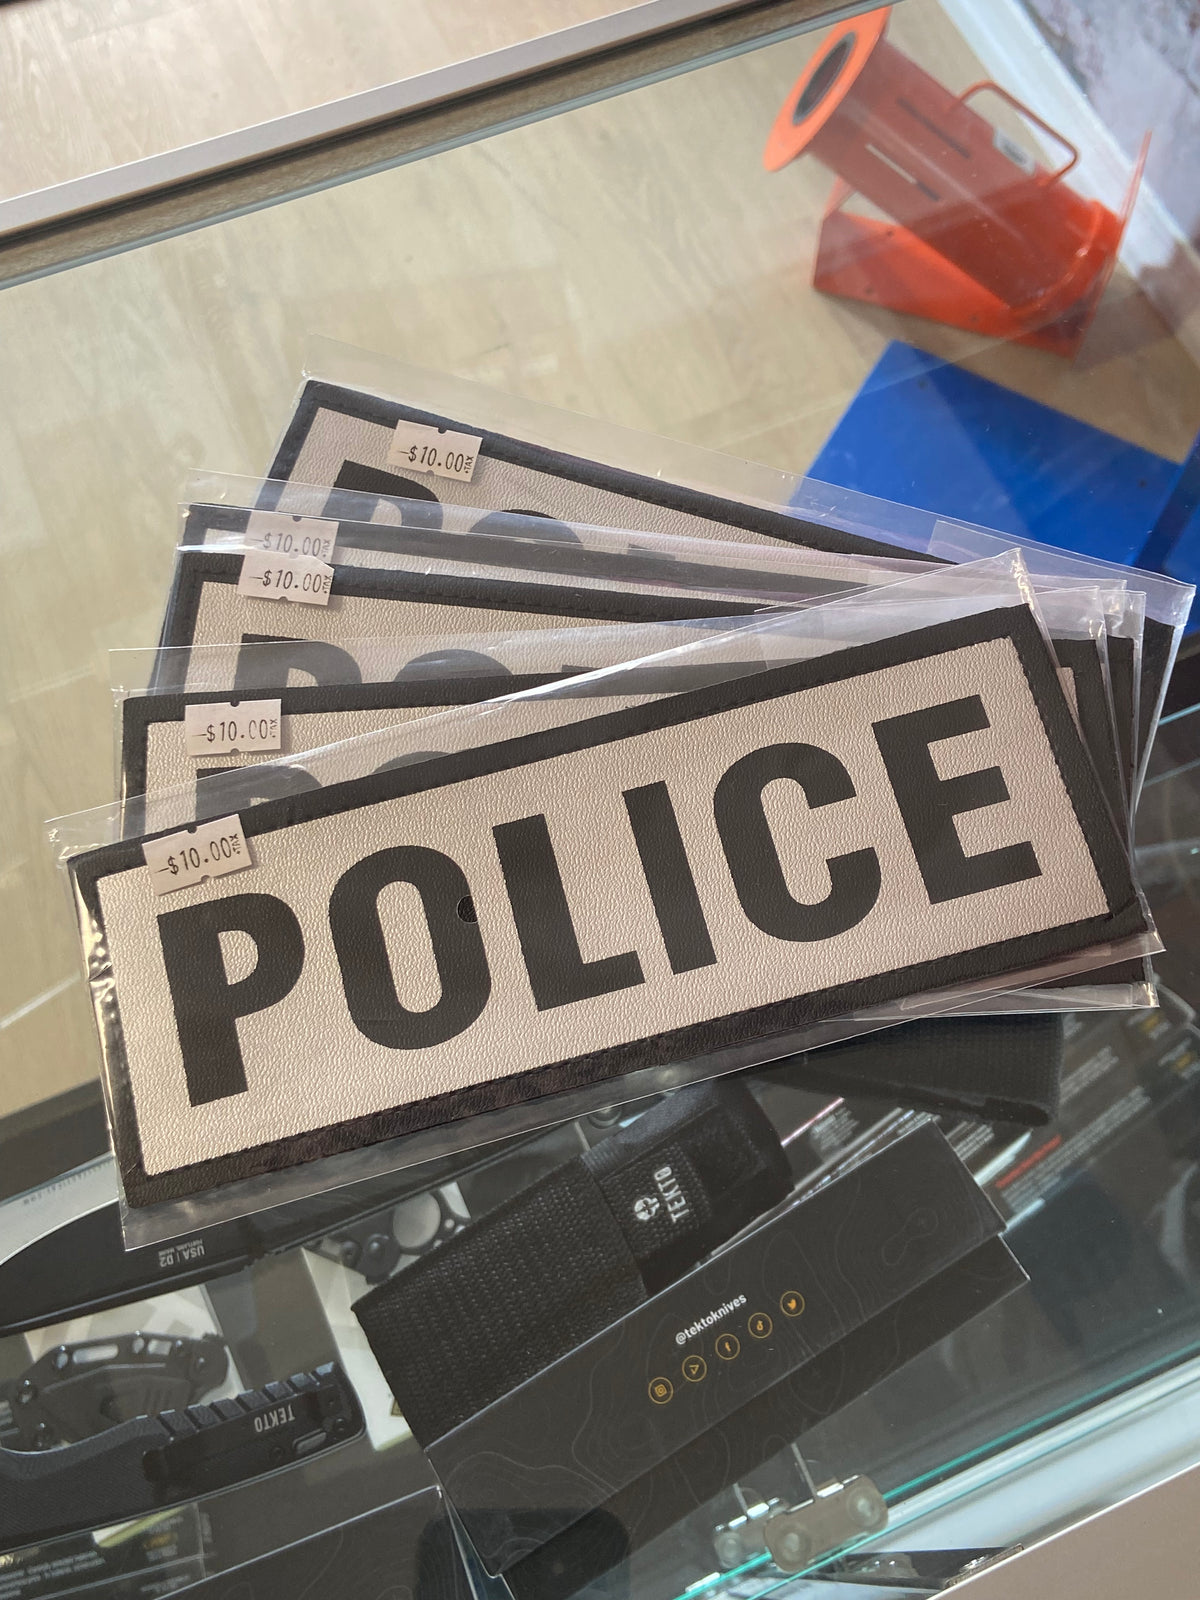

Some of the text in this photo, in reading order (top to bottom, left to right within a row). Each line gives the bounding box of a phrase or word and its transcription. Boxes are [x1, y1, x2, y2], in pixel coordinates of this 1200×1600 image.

[157, 694, 1042, 1107] POLICE
[654, 1166, 690, 1223] TEKTO
[159, 1254, 174, 1268] D2
[182, 1245, 205, 1260] USA
[675, 1294, 747, 1345] @tektoknives
[254, 1404, 296, 1432] TEKTO
